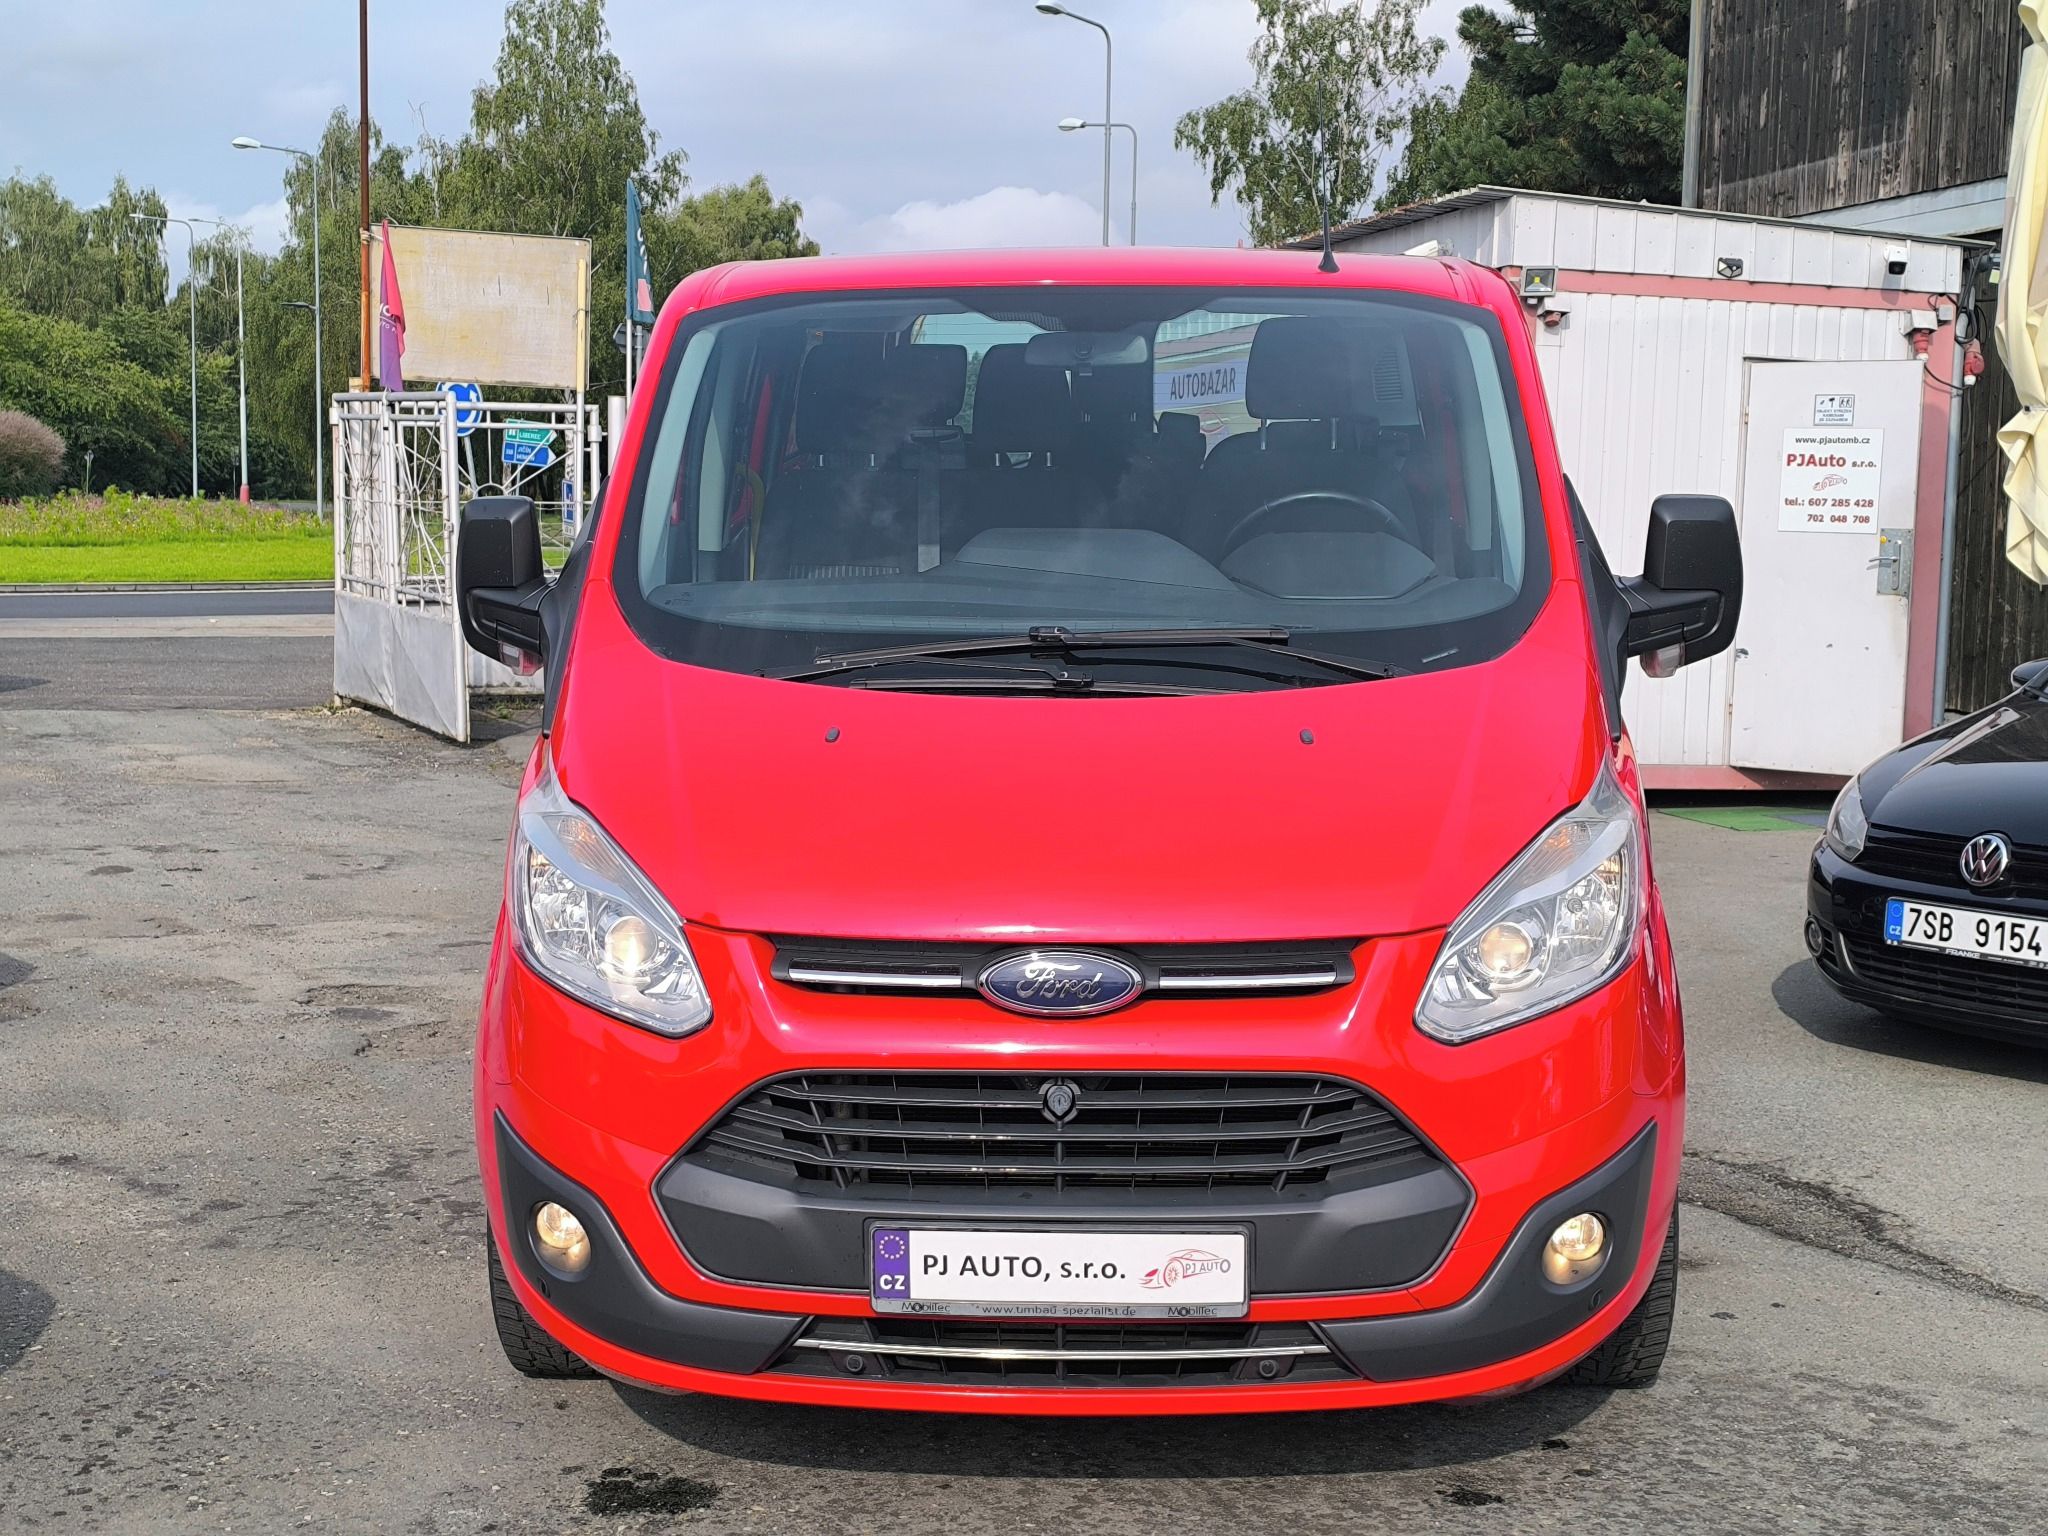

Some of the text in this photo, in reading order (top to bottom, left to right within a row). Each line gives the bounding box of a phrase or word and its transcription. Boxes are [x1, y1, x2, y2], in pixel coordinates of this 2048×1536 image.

[1170, 367, 1236, 400] AUTOBAZAR
[1795, 436, 1870, 445] www.pjautomb.cz
[1786, 453, 1877, 468] PJAuto s.r.o.
[1784, 497, 1874, 508] tel.: 607 285 428
[1807, 514, 1870, 524] 702 048 708
[1889, 924, 1901, 936] CZ
[1908, 907, 2042, 956] 7SB 9154
[1945, 948, 1981, 960] FRANKE
[1016, 961, 1103, 999] Ford
[923, 1254, 1126, 1282] PJ AUTO, s.r.o.
[1185, 1258, 1231, 1274] PJ AUTO
[879, 1274, 906, 1290] CZ
